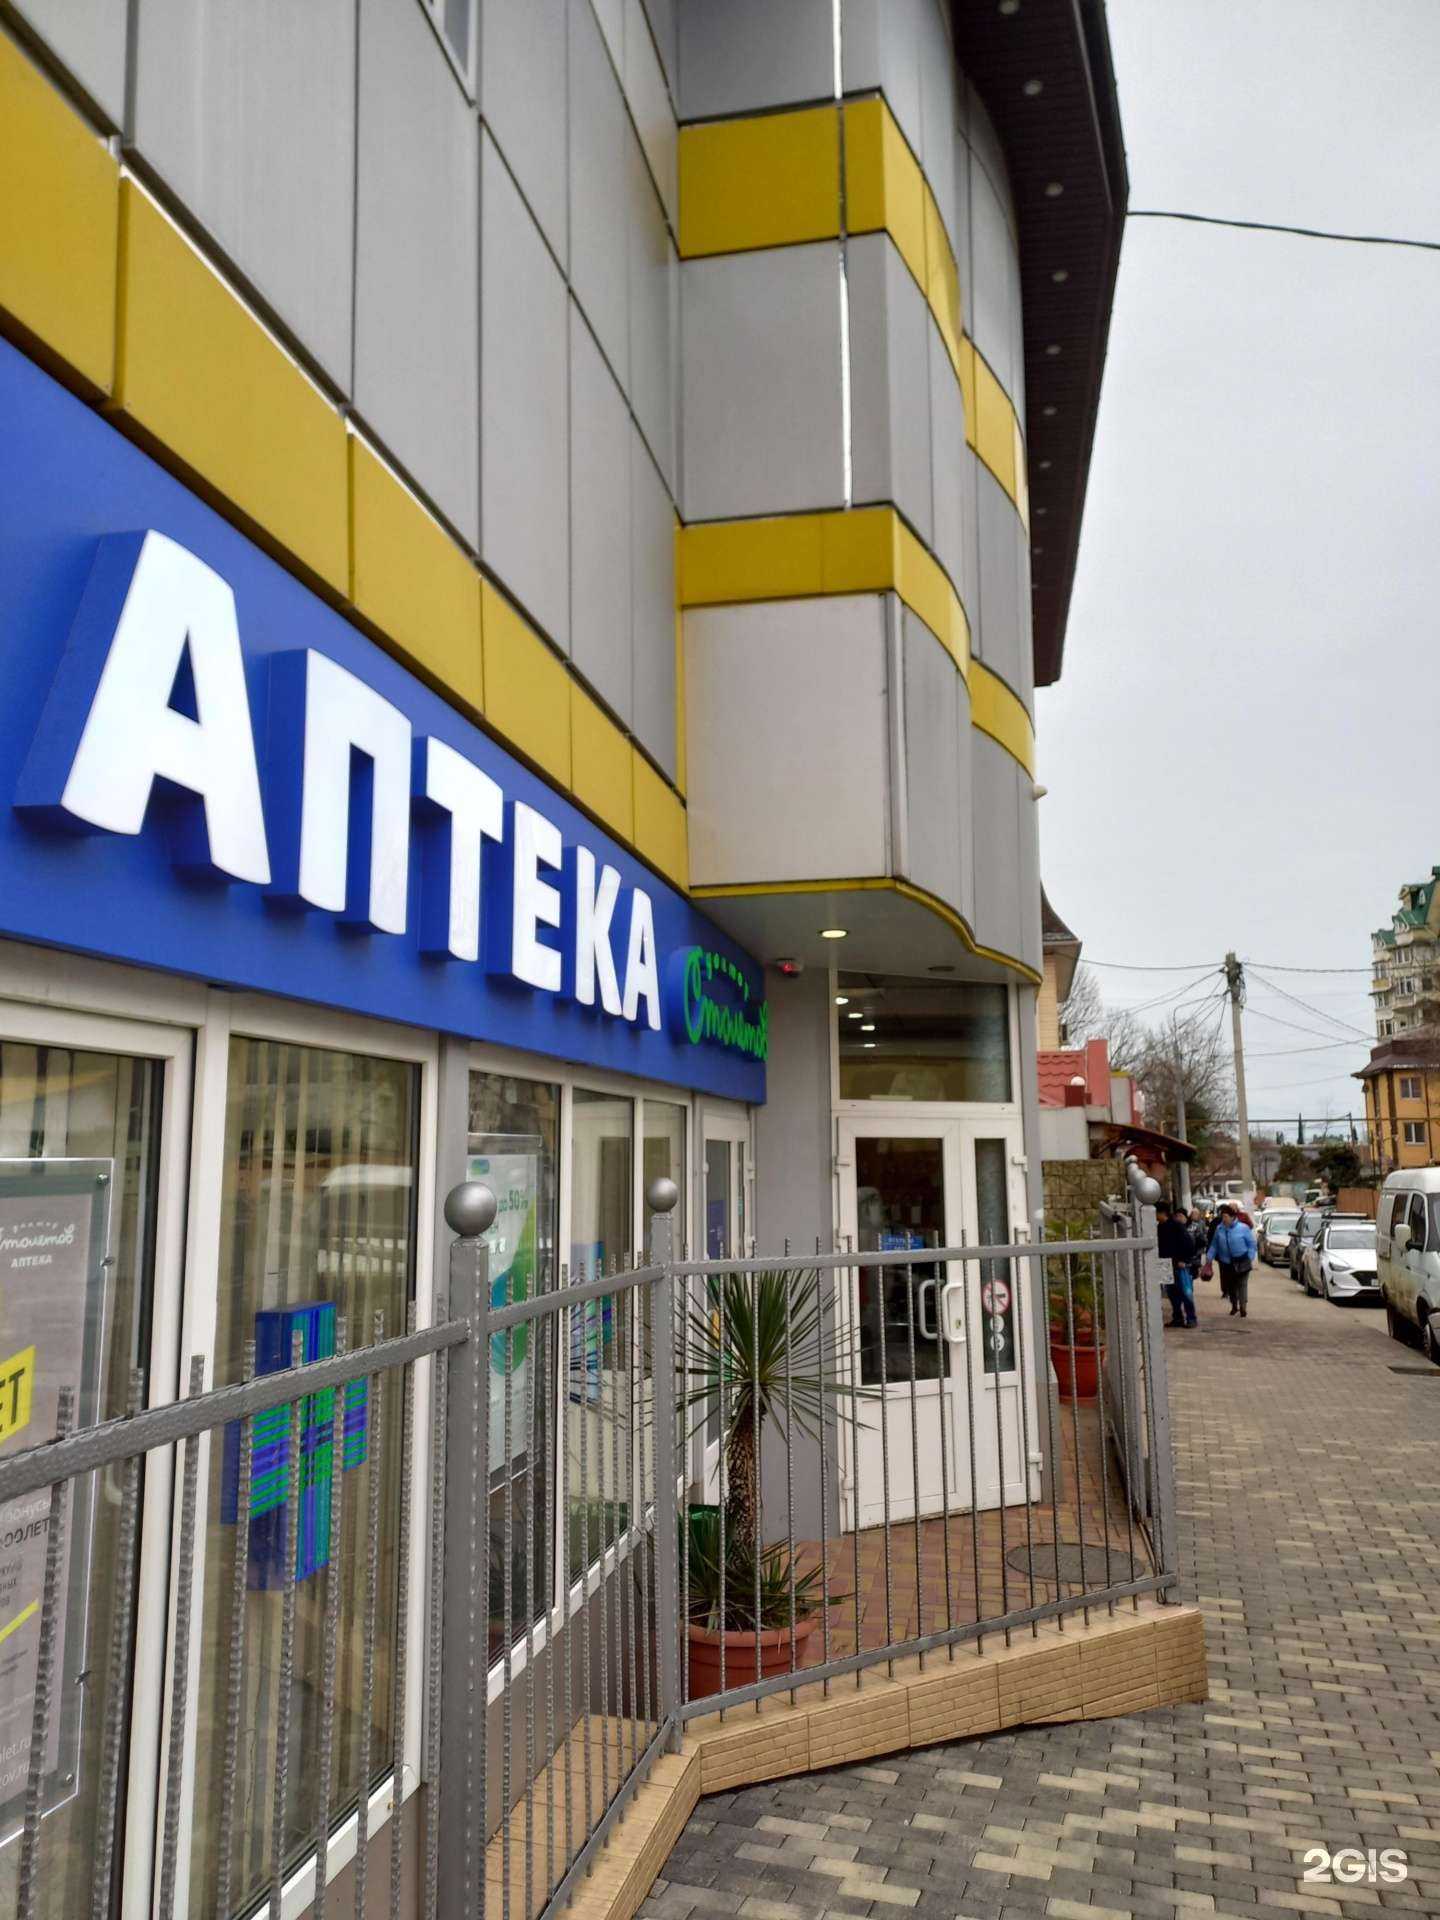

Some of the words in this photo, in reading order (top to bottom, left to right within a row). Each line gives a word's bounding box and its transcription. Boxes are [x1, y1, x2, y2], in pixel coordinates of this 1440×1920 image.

[61, 529, 661, 1031] АПТЕКА
[0, 1224, 75, 1250] толетов
[11, 1255, 52, 1268] АПТЕКА
